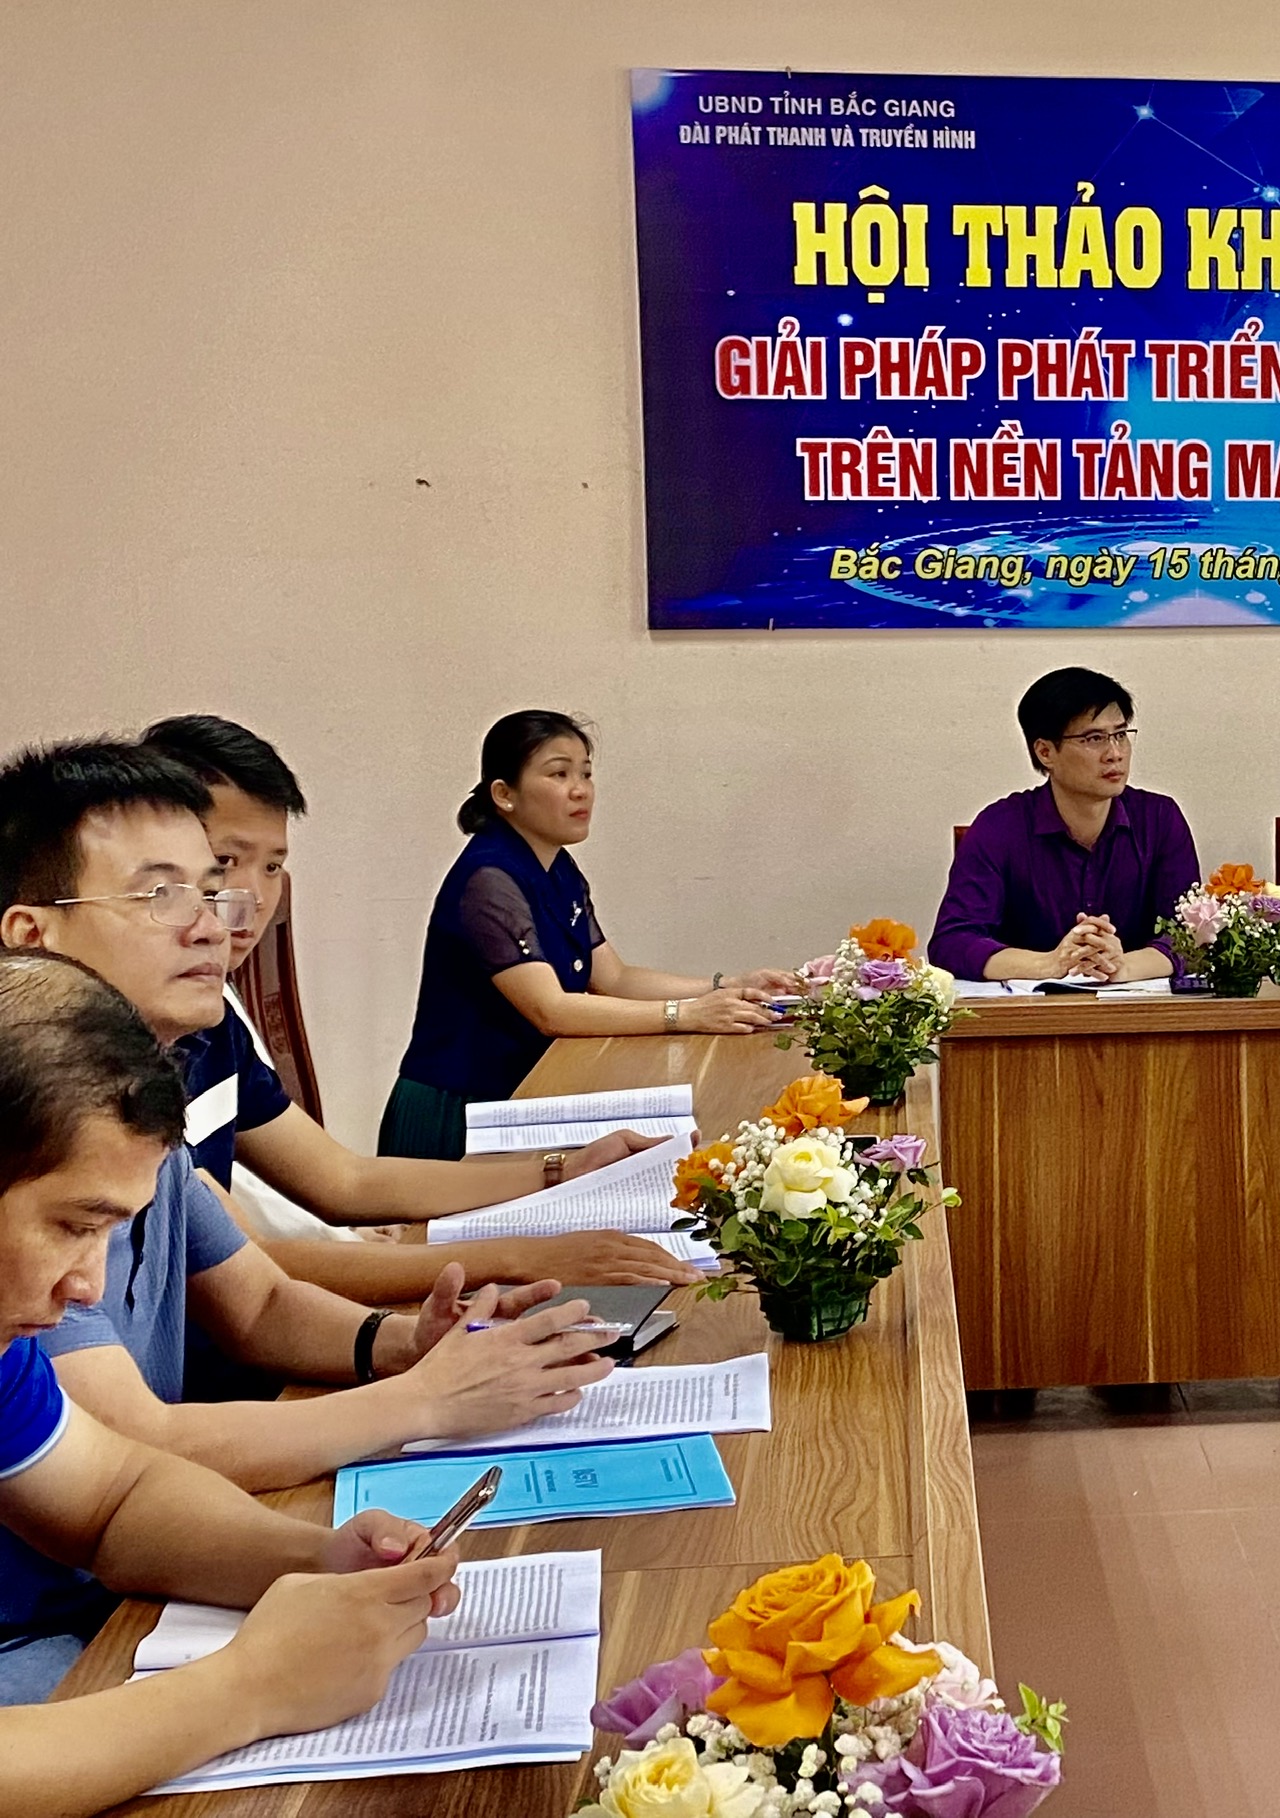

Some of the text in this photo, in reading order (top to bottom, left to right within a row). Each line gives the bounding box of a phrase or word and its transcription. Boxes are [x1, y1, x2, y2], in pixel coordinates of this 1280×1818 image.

[679, 121, 710, 144] ĐÀI
[715, 121, 762, 145] PHÁT
[766, 126, 827, 147] THANH
[831, 124, 855, 147] VÀ
[933, 125, 976, 149] HÌNH
[699, 90, 956, 118] UBND TỈNH BẮC GIANG
[792, 184, 930, 303] HỘI
[951, 181, 1163, 290] THẢO
[715, 316, 828, 400] GIẢI
[839, 325, 986, 401] PHÁP
[998, 326, 1136, 401] PHÁT
[796, 425, 938, 501] TRÊN
[949, 419, 1062, 501] NỀN
[1072, 420, 1211, 501] TẢNG
[829, 543, 903, 581] Bắc
[914, 548, 1032, 587] Giang,
[1046, 551, 1137, 587] ngày
[1148, 548, 1191, 580] 15
